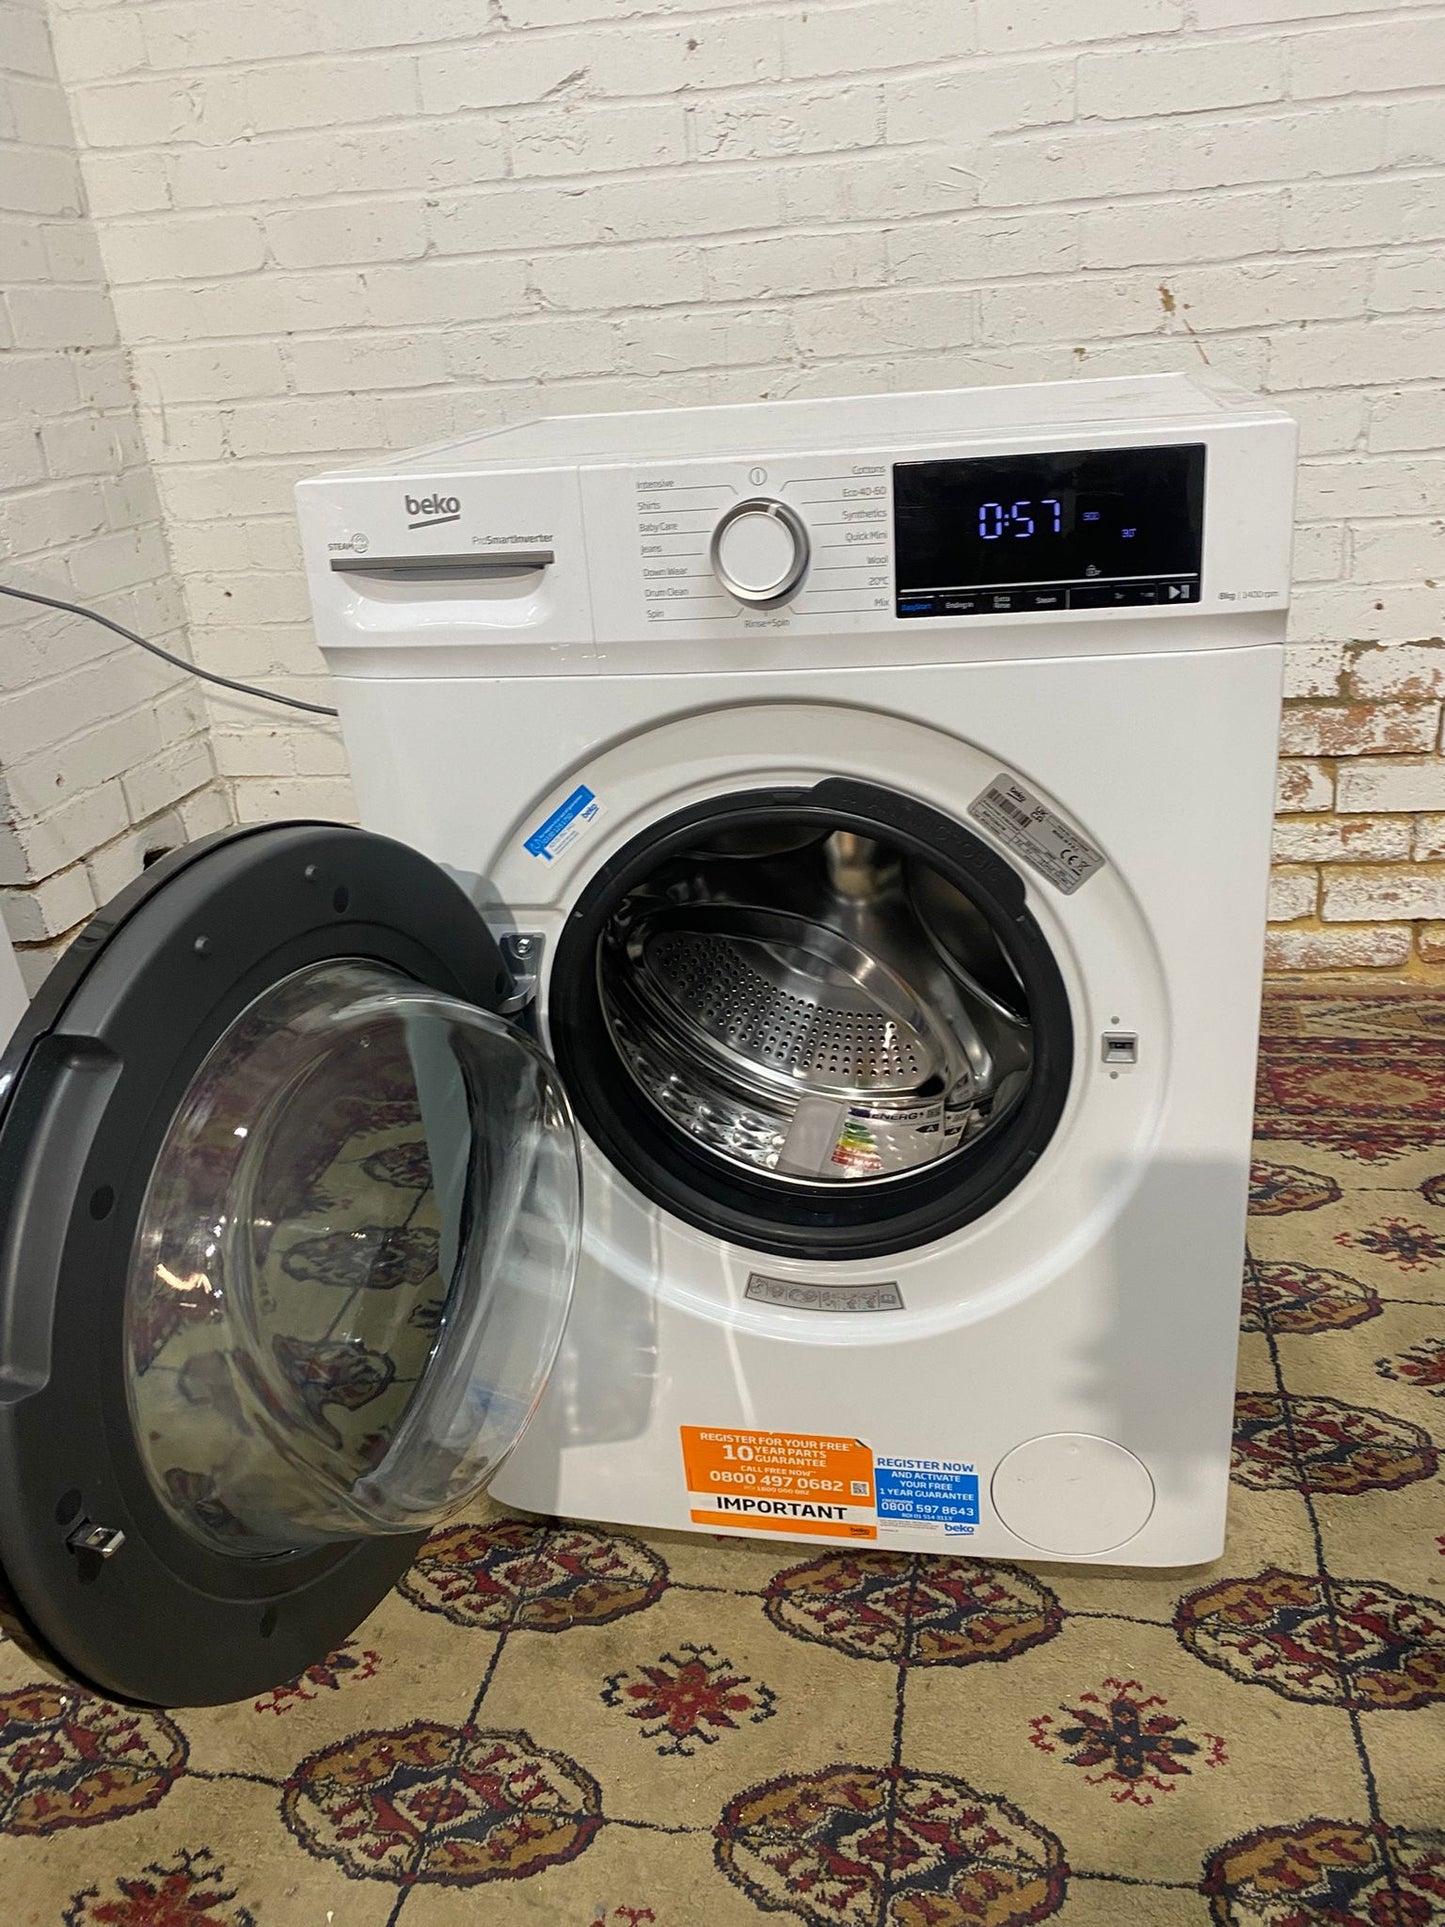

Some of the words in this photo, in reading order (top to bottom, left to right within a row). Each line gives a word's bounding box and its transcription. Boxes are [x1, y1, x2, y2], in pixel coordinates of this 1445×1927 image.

[636, 480, 675, 489] Intensive
[405, 493, 461, 515] beko
[637, 501, 661, 510] Shirts
[842, 510, 888, 521] Synthetics
[979, 500, 1061, 539] 0:57
[846, 532, 869, 542] Quick
[870, 531, 888, 540] Mini
[867, 555, 888, 564] Wool
[643, 568, 666, 577] Down
[645, 588, 665, 597] Drum
[667, 587, 689, 596] Clean
[874, 598, 890, 607] Mix
[647, 609, 665, 619] Spin
[871, 1112, 918, 1121] ENERG
[700, 1432, 756, 1445] REGISTER
[758, 1436, 782, 1447] FOR
[784, 1438, 818, 1450] YOUR
[722, 1444, 754, 1462] 10
[754, 1446, 785, 1457] YEAR
[788, 1448, 827, 1459] PARTS
[755, 1455, 827, 1467] GUARANTEE
[877, 1457, 940, 1470] REGISTER
[943, 1462, 974, 1472] NOW
[740, 1465, 762, 1473] CALL
[764, 1467, 787, 1475] FREE
[709, 1470, 756, 1484] 0800
[760, 1474, 793, 1488] 497
[797, 1478, 844, 1492] 0682
[891, 1471, 912, 1479] AND
[914, 1472, 961, 1483] ACTIVATE
[900, 1480, 927, 1489] YOUR
[928, 1482, 953, 1491] FREE
[880, 1487, 885, 1495] 1
[887, 1488, 913, 1497] YEAR
[915, 1490, 975, 1502] GUARANTEE
[717, 1496, 848, 1520] IMPORTANT
[881, 1502, 913, 1512] 0800
[916, 1504, 940, 1514] 597
[942, 1506, 974, 1517] 8643
[944, 1523, 975, 1533] beko
